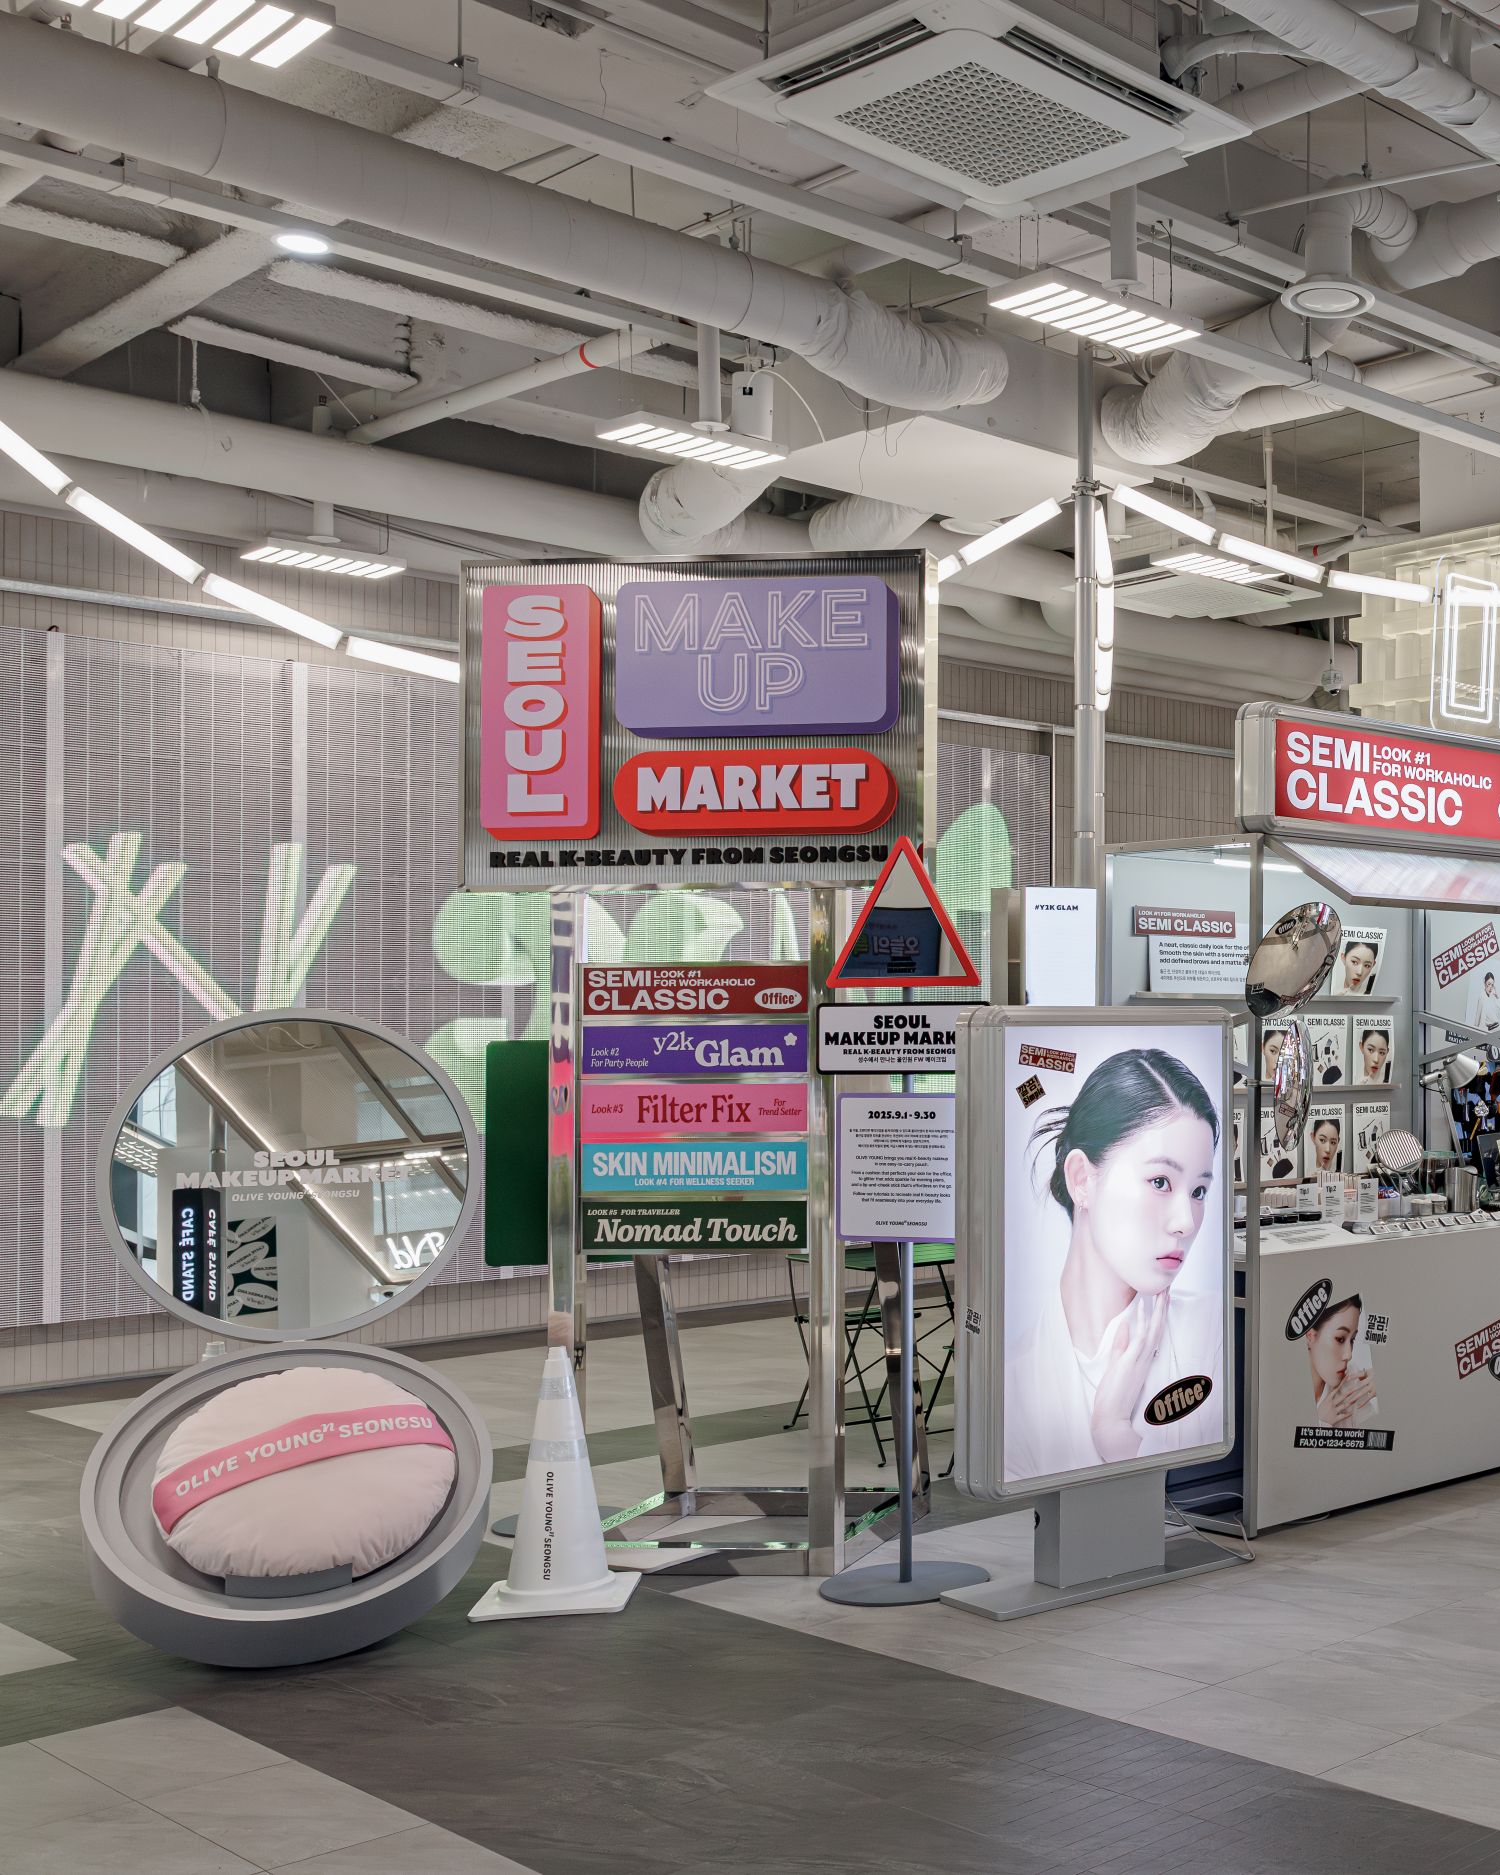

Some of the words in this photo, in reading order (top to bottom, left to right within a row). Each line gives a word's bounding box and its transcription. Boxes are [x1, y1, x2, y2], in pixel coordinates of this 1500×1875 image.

[633, 588, 868, 652] MAKE
[697, 652, 804, 712] UP
[504, 594, 565, 813] SEOUL
[1286, 730, 1371, 774] SEMI
[1372, 745, 1411, 763] LOOK
[1414, 751, 1431, 767] #1
[1372, 761, 1402, 777] FOR
[1404, 767, 1492, 790] WORKAHOLIC
[636, 764, 866, 812] MARKET
[1286, 768, 1463, 828] CLASSIC
[490, 849, 554, 868] REAL
[559, 847, 685, 867] K-BEAUTY
[692, 846, 765, 865] FROM
[769, 844, 888, 864] SEONGSU
[1138, 918, 1171, 931] SEMI
[1174, 919, 1233, 934] CLASSIC
[1356, 930, 1384, 940] CLASSIC
[1462, 930, 1495, 954] WORKAHOLIC
[1434, 944, 1463, 970] SEMI
[1438, 938, 1498, 986] CLASSIC
[588, 970, 651, 987] SEMI
[653, 970, 685, 979] LOOK
[687, 970, 701, 978] #1
[653, 979, 677, 987] FOR
[678, 978, 755, 987] WORKAHOLIC
[588, 989, 730, 1011] CLASSIC
[873, 1014, 931, 1029] SEOUL
[1323, 1018, 1345, 1026] CLASSIC
[1370, 1019, 1391, 1027] CLASSIC
[824, 1031, 900, 1046] MAKEUP
[591, 1047, 608, 1057] Look
[610, 1047, 620, 1056] #2
[653, 1030, 694, 1056] y2k
[695, 1039, 784, 1067] Glam
[1021, 1045, 1047, 1057] SEMI
[591, 1058, 602, 1067] For
[604, 1058, 624, 1069] Party
[625, 1058, 648, 1068] People
[1020, 1054, 1075, 1072] CLASSIC
[591, 1104, 611, 1114] Look
[637, 1094, 707, 1124] Filter
[711, 1094, 752, 1123] Fix
[773, 1098, 786, 1107] For
[1369, 1105, 1389, 1113] CLASSIC
[758, 1107, 779, 1116] Trend
[781, 1107, 802, 1116] Setter
[868, 1110, 908, 1119] 2025.9.1
[914, 1111, 936, 1120] 9.30
[1322, 1107, 1343, 1116] CLASSIC
[254, 1150, 340, 1168] SEOUL
[592, 1151, 647, 1177] SKIN
[653, 1151, 797, 1176] MINIMALISM
[176, 1170, 297, 1189] MAKEUP
[300, 1166, 412, 1185] MARKET
[634, 1178, 654, 1186] LOOK
[670, 1178, 684, 1186] FOR
[686, 1178, 725, 1186] WELLNESS
[726, 1177, 755, 1186] SEEKER
[232, 1192, 264, 1202] OLIVE
[637, 1208, 680, 1216] TRAVELLER
[594, 1218, 702, 1243] Nomad
[707, 1217, 798, 1242] Touch
[1367, 1314, 1389, 1331] 깔끔!
[1365, 1329, 1387, 1344] Simple
[1456, 1330, 1490, 1358] SEMI
[1300, 1428, 1314, 1436] It's
[1315, 1428, 1333, 1437] time
[1334, 1429, 1343, 1437] to
[1344, 1429, 1365, 1438] work!
[1299, 1438, 1318, 1448] FAX)
[1318, 1439, 1364, 1448] 0-1234-5678
[175, 1456, 240, 1498] OLIVE
[338, 1415, 433, 1440] SEONGSU
[545, 1471, 554, 1498] OLIVE
[543, 1537, 552, 1581] SEONGSU
